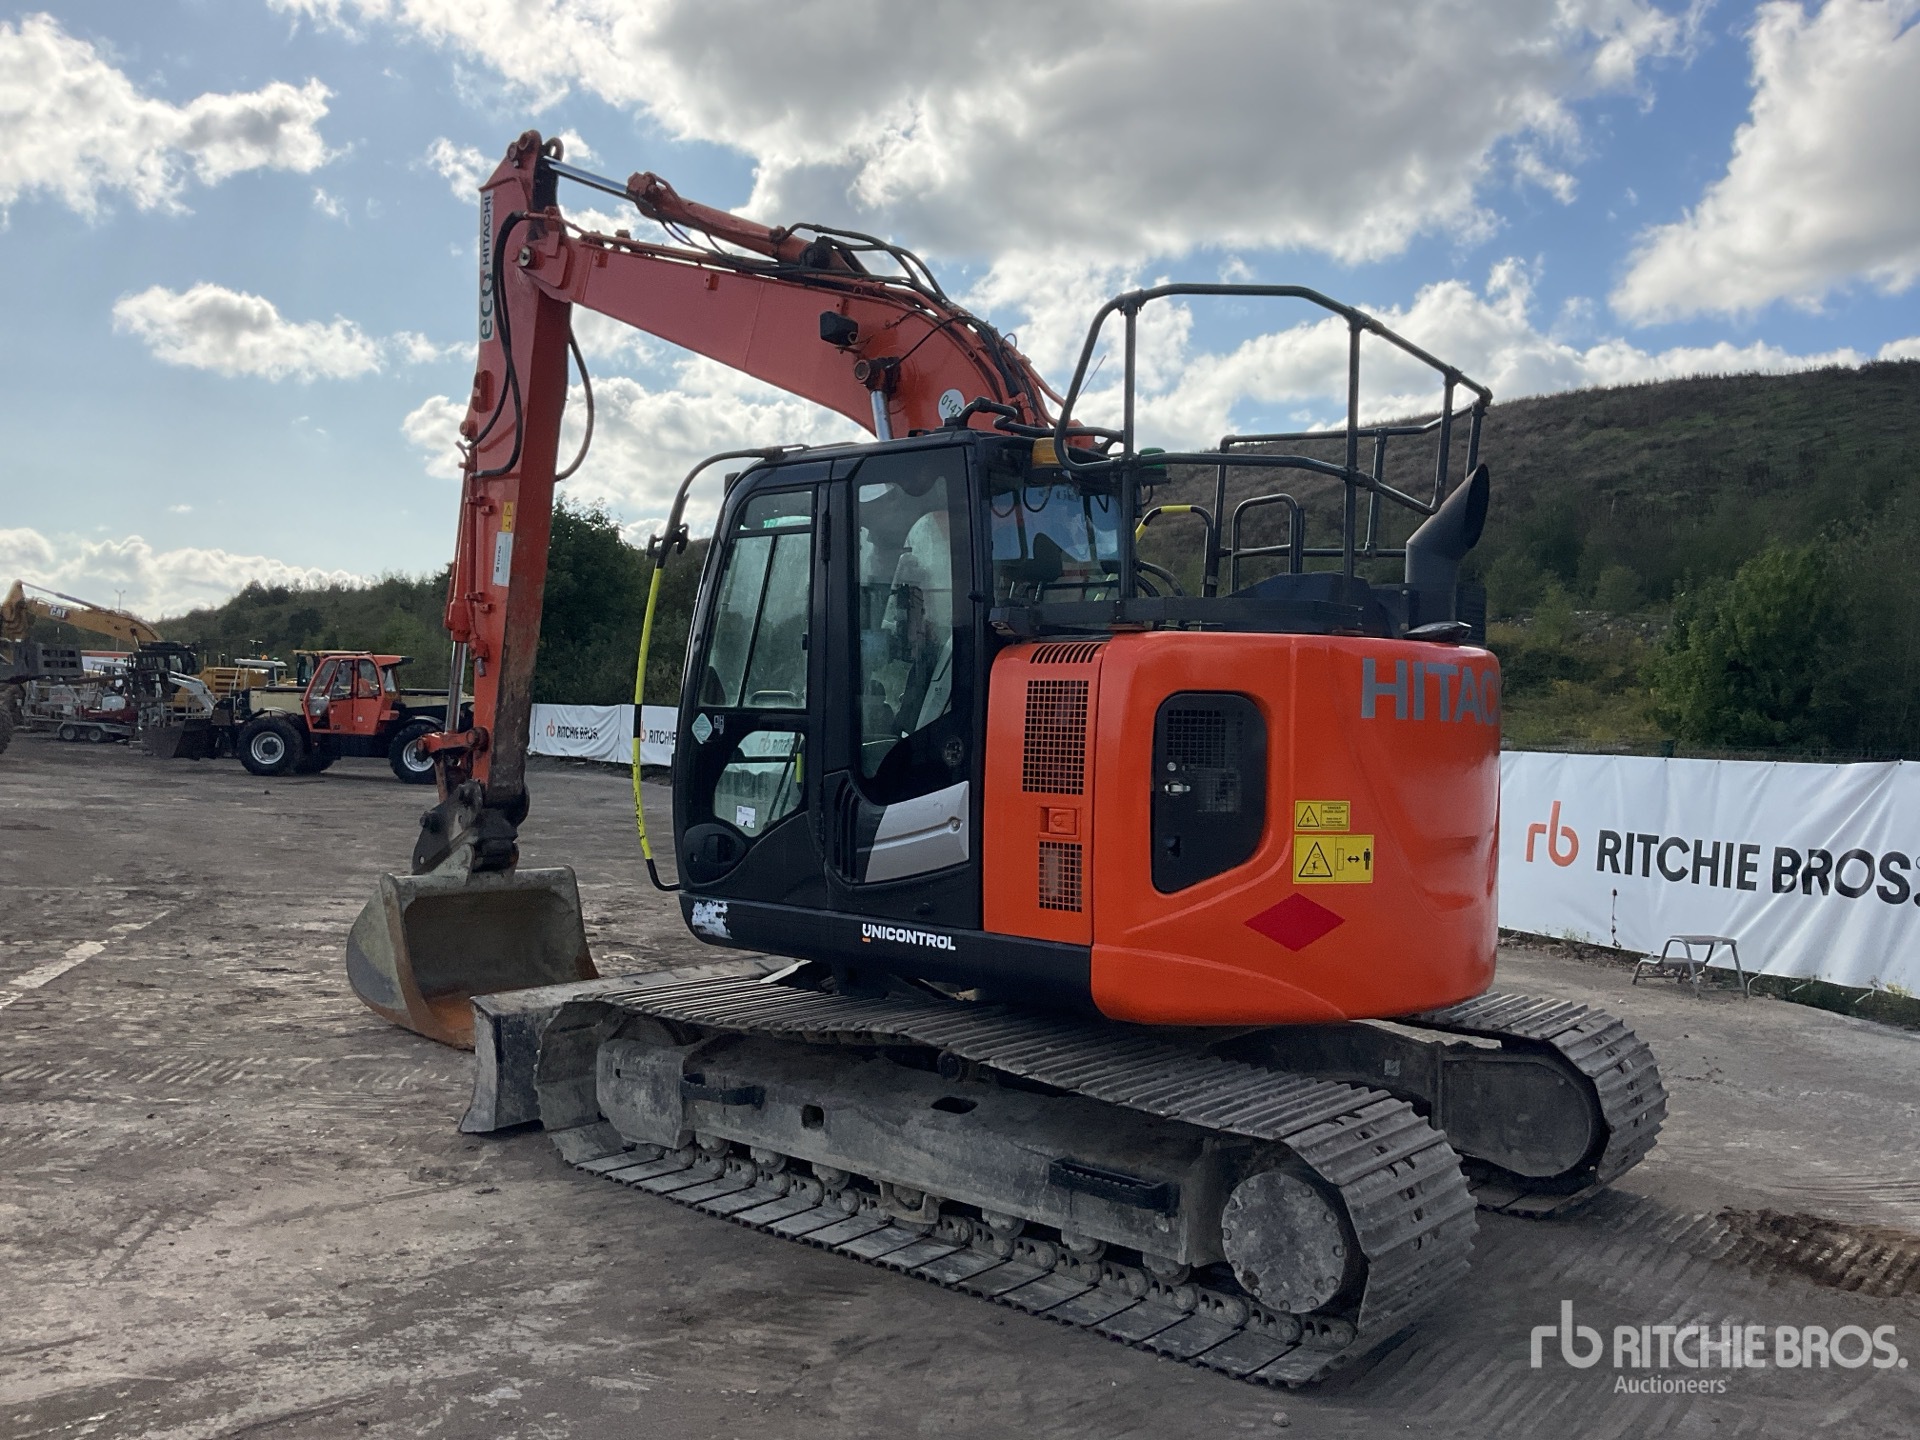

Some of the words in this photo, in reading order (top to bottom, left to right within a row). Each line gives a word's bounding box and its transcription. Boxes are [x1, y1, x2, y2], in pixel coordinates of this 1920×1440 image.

[483, 195, 491, 266] HITACHI
[556, 725, 579, 739] RITCHIE
[1525, 800, 1579, 867] rb
[1596, 829, 1761, 892] RITCHIE
[862, 923, 956, 951] UNICONTROL
